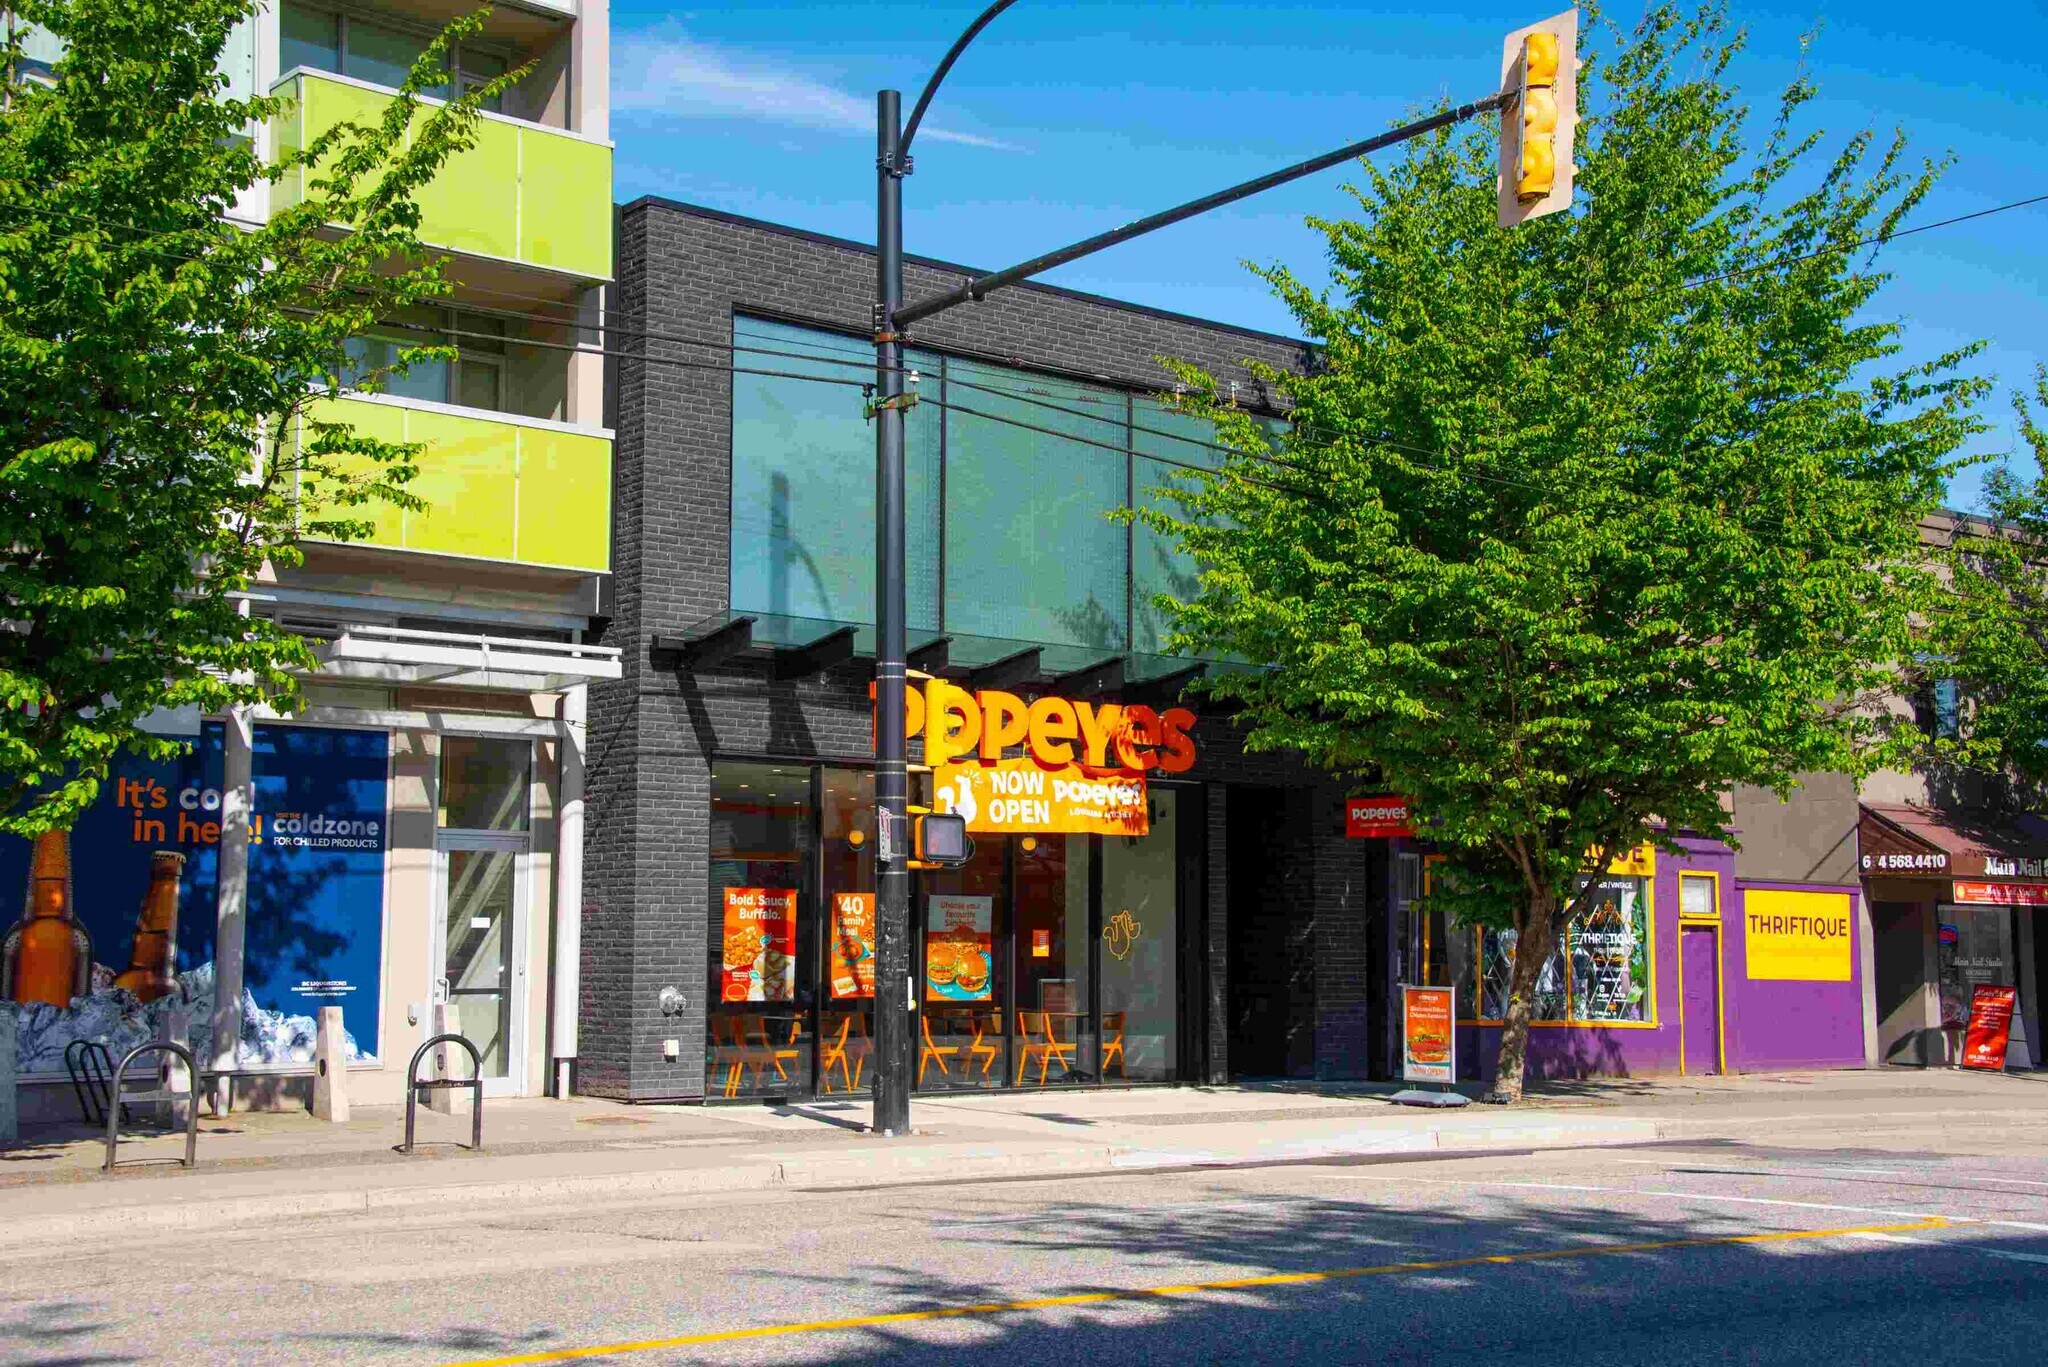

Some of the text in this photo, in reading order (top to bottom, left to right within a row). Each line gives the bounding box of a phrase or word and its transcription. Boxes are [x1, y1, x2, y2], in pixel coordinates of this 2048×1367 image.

[989, 770, 1045, 795] NOW
[117, 776, 255, 811] It's col
[988, 798, 1051, 824] OPEN
[133, 809, 263, 844] in he!
[273, 813, 380, 836] coldzone
[273, 836, 378, 848] FOR CHILLED PRODUCTS
[1985, 856, 2015, 875] Main
[2017, 857, 2042, 876] Nail
[729, 893, 792, 909] Bold. Saucy.
[739, 907, 781, 920] Buffalo.
[837, 915, 866, 927] Family
[837, 927, 859, 936] Meal
[1748, 914, 1847, 940] THRIFTIQUE
